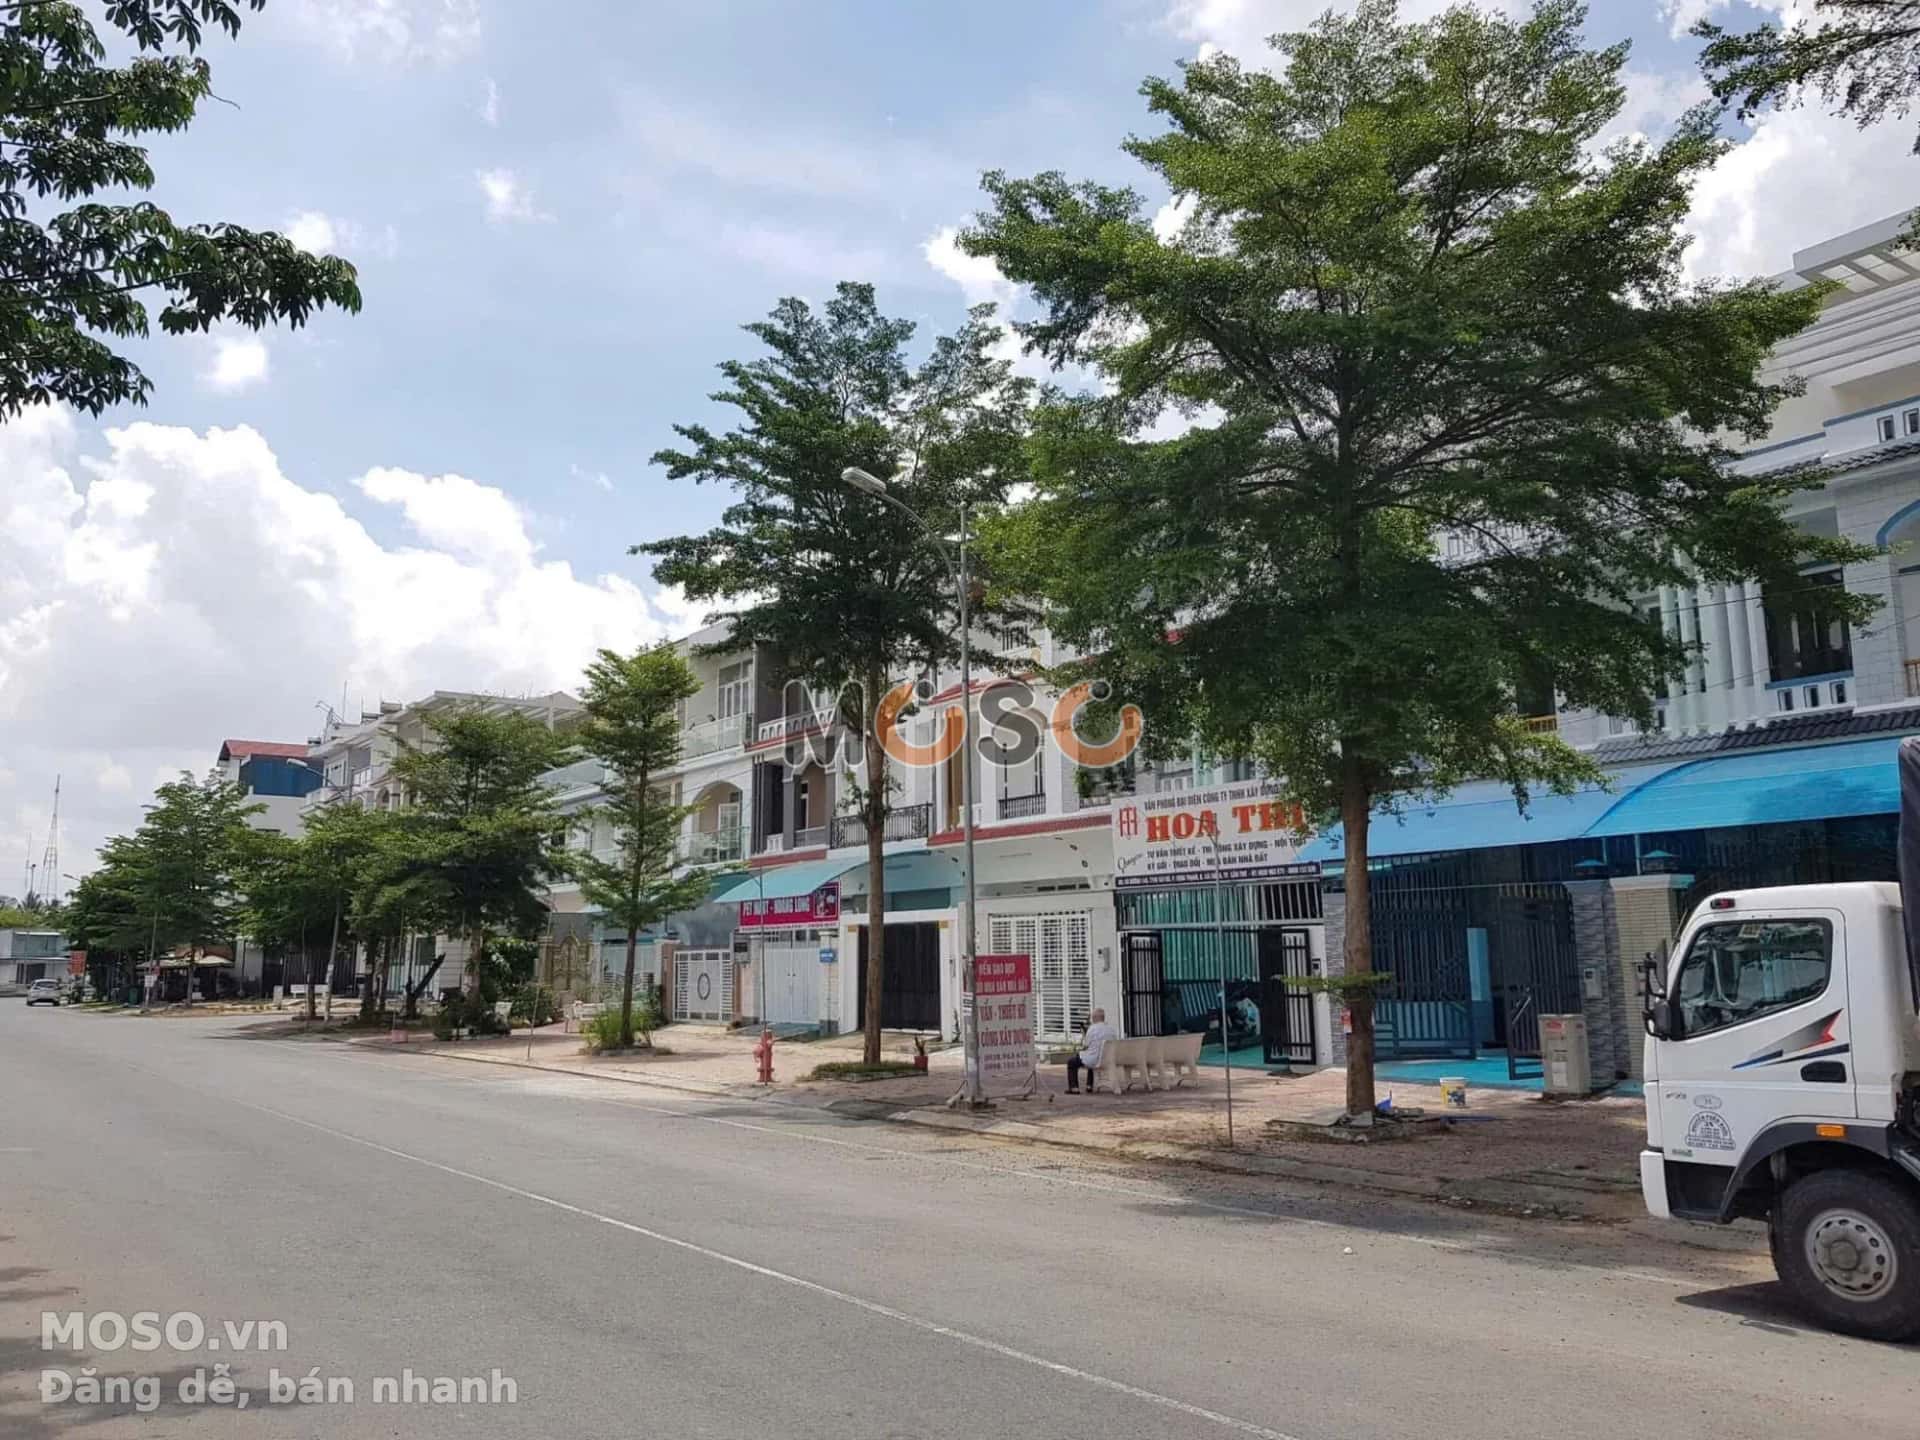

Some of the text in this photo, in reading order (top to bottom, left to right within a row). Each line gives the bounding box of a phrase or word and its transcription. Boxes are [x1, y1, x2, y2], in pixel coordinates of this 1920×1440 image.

[1202, 791, 1219, 804] CÔNG
[1220, 791, 1228, 802] TY
[1246, 785, 1258, 798] XÂY
[1146, 809, 1220, 843] HOA
[1187, 844, 1196, 855] KẾ
[1201, 845, 1213, 855] THI
[1234, 840, 1247, 851] XÂY
[1248, 839, 1268, 850] DỰNG
[1274, 836, 1288, 848] NỘI
[1238, 853, 1252, 864] NHÀ
[1253, 852, 1268, 863] ĐẤT
